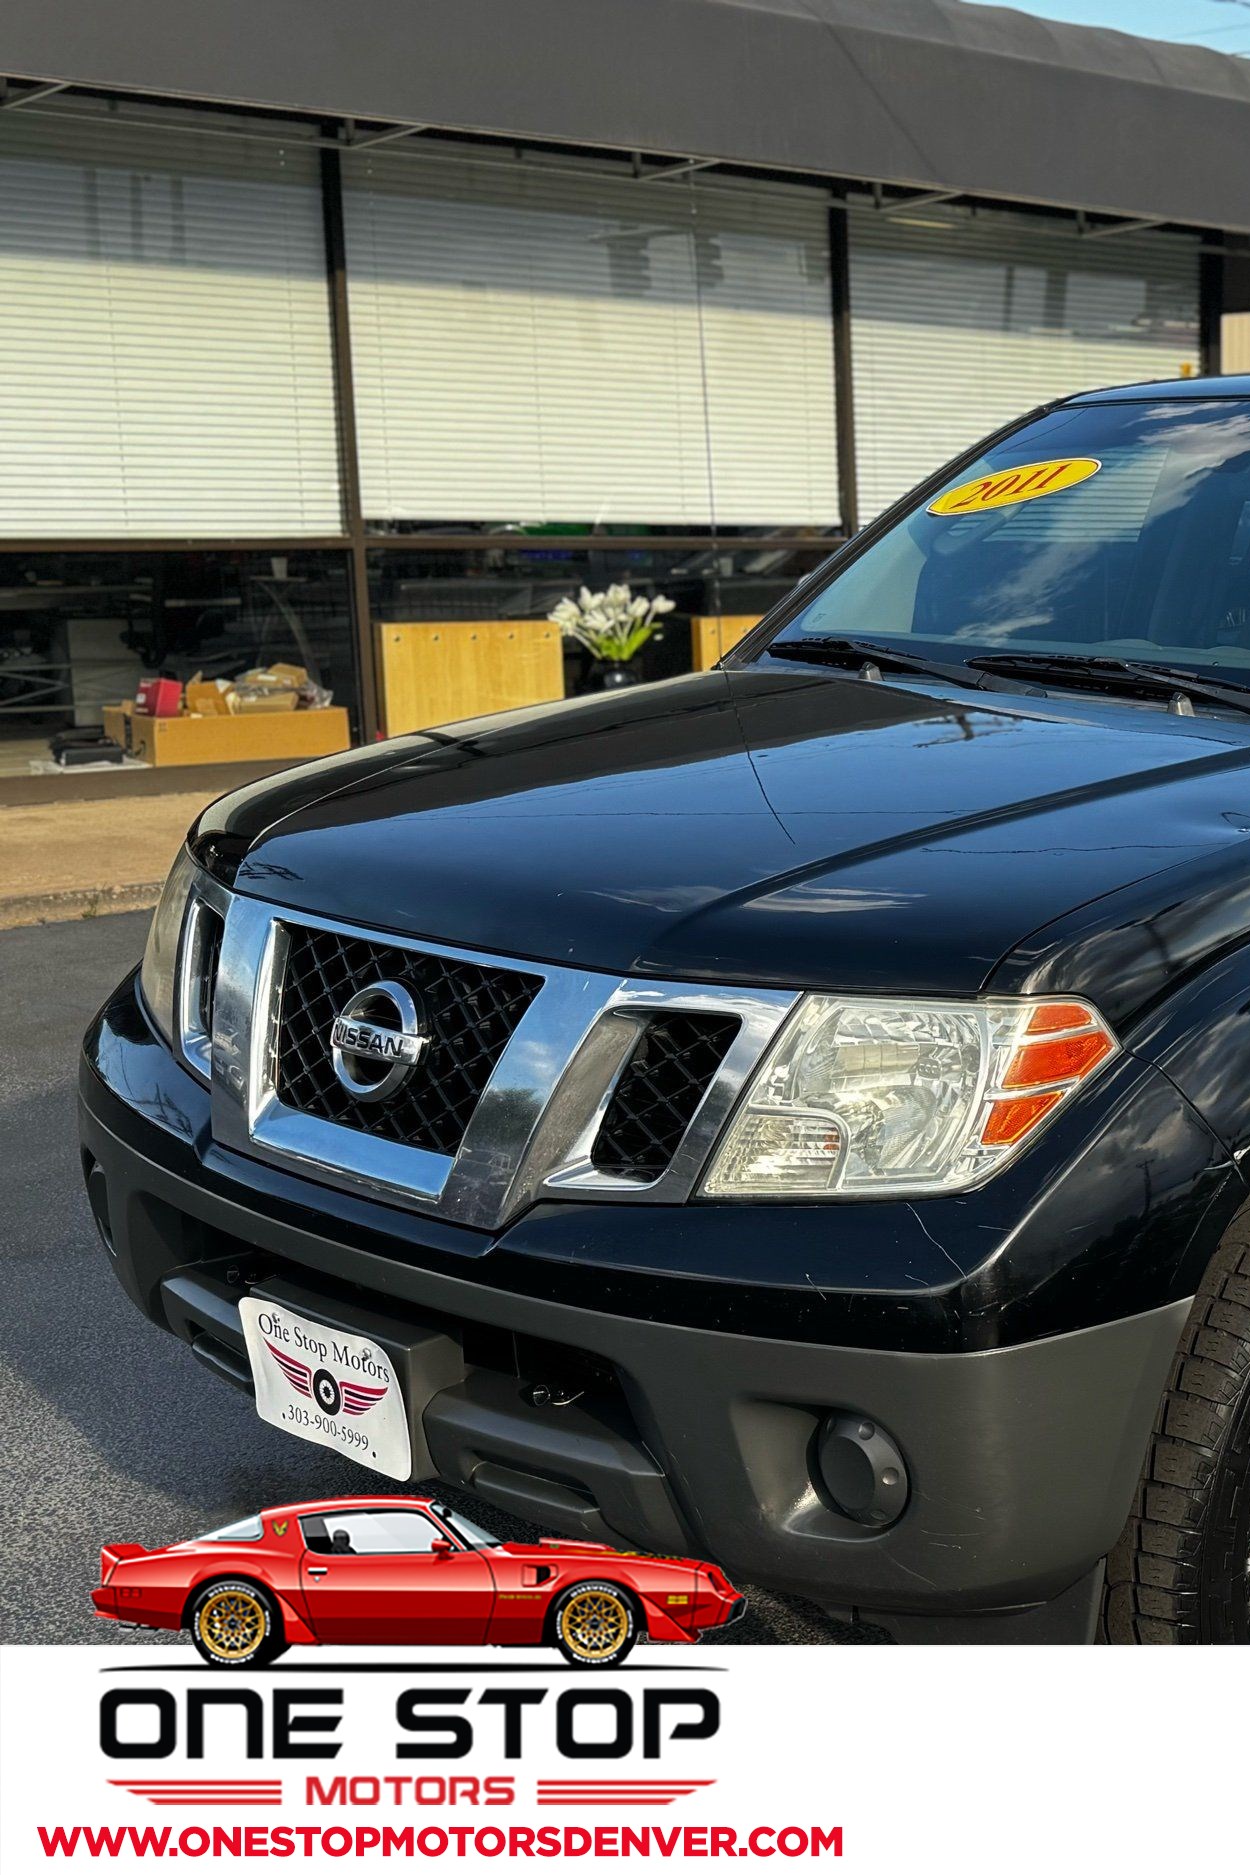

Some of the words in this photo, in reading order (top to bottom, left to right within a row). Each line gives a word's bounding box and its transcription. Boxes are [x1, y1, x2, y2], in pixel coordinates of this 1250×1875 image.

[949, 462, 1073, 510] 2011
[334, 1021, 404, 1057] NISSAN
[258, 1313, 290, 1343] One
[294, 1326, 327, 1363] Stop
[331, 1340, 390, 1383] Motors
[287, 1404, 370, 1451] 303-900-5999
